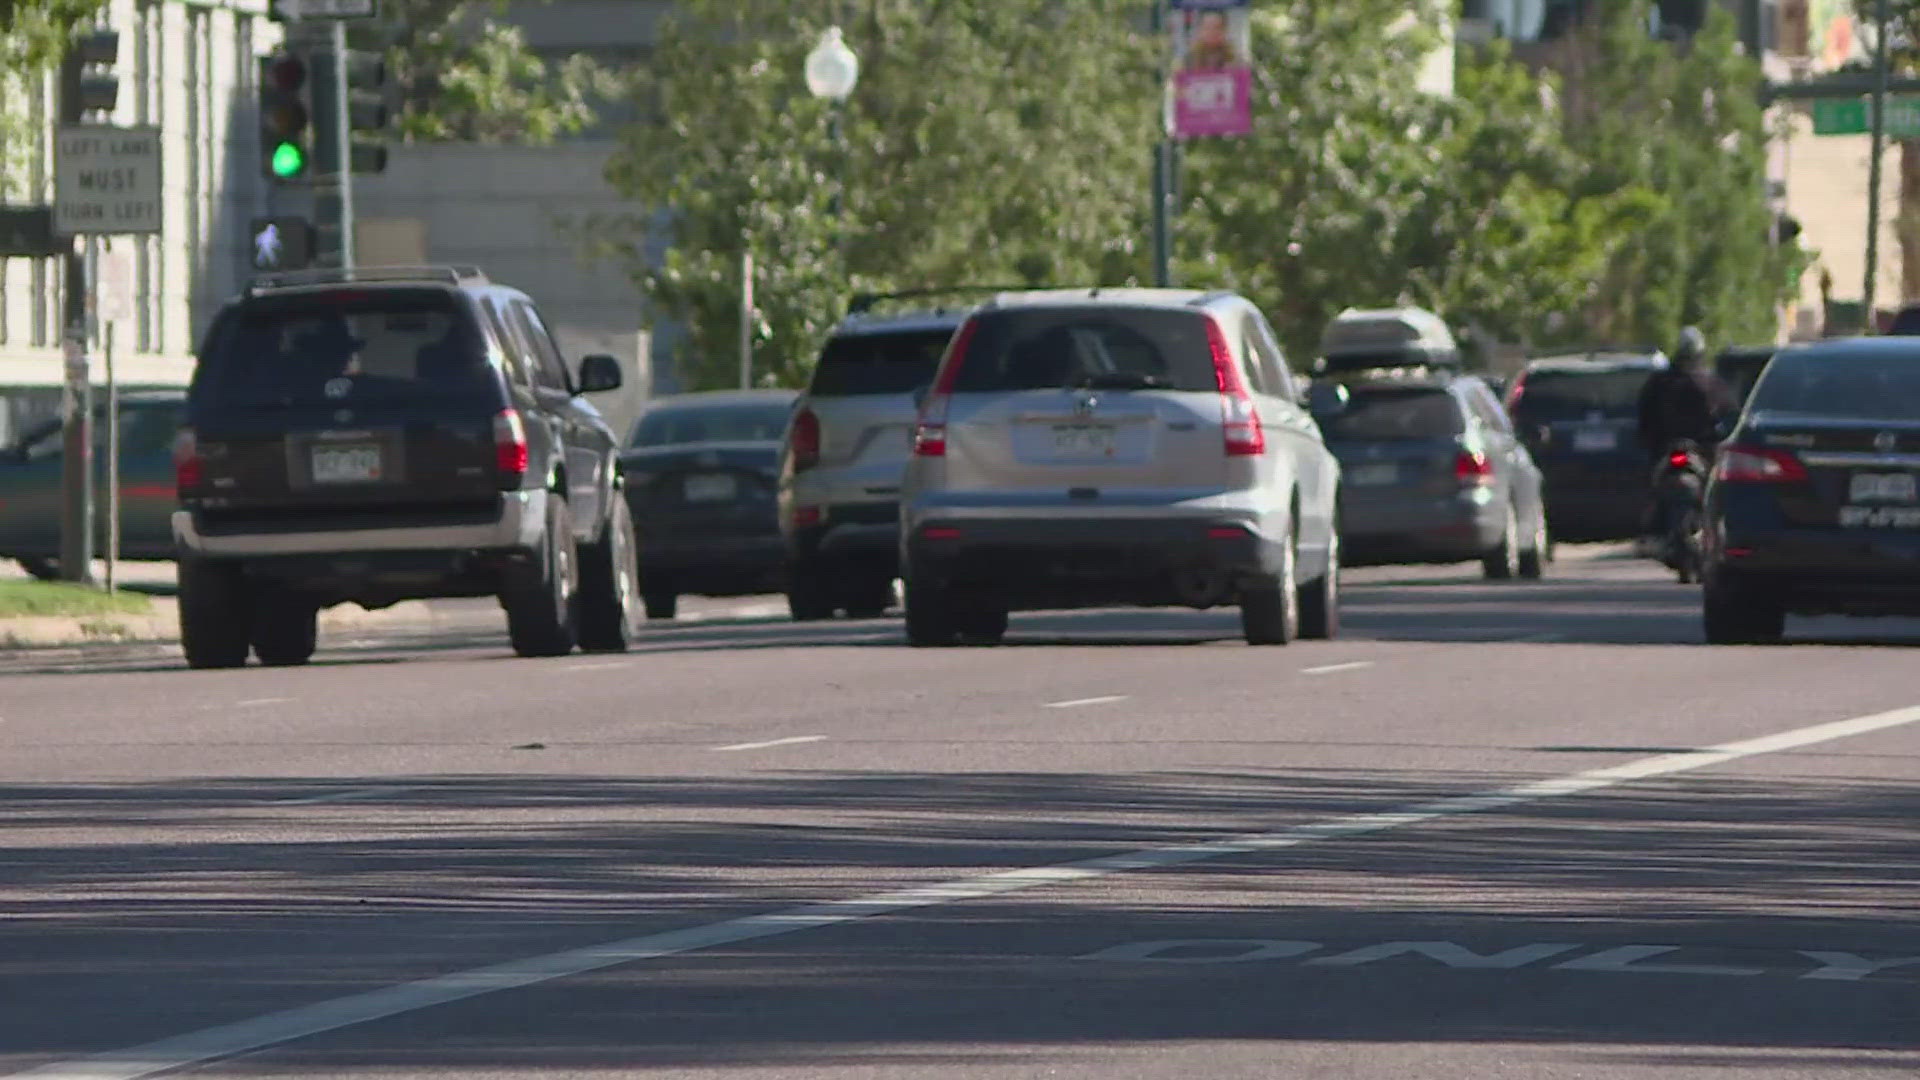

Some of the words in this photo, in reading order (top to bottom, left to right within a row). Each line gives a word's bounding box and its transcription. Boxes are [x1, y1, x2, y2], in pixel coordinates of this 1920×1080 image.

[62, 138, 101, 155] LEFT
[111, 138, 151, 155] LANE
[79, 168, 136, 190] MUST
[62, 201, 104, 219] TURN
[114, 201, 154, 219] LEFT
[1070, 939, 1920, 980] ONLY
